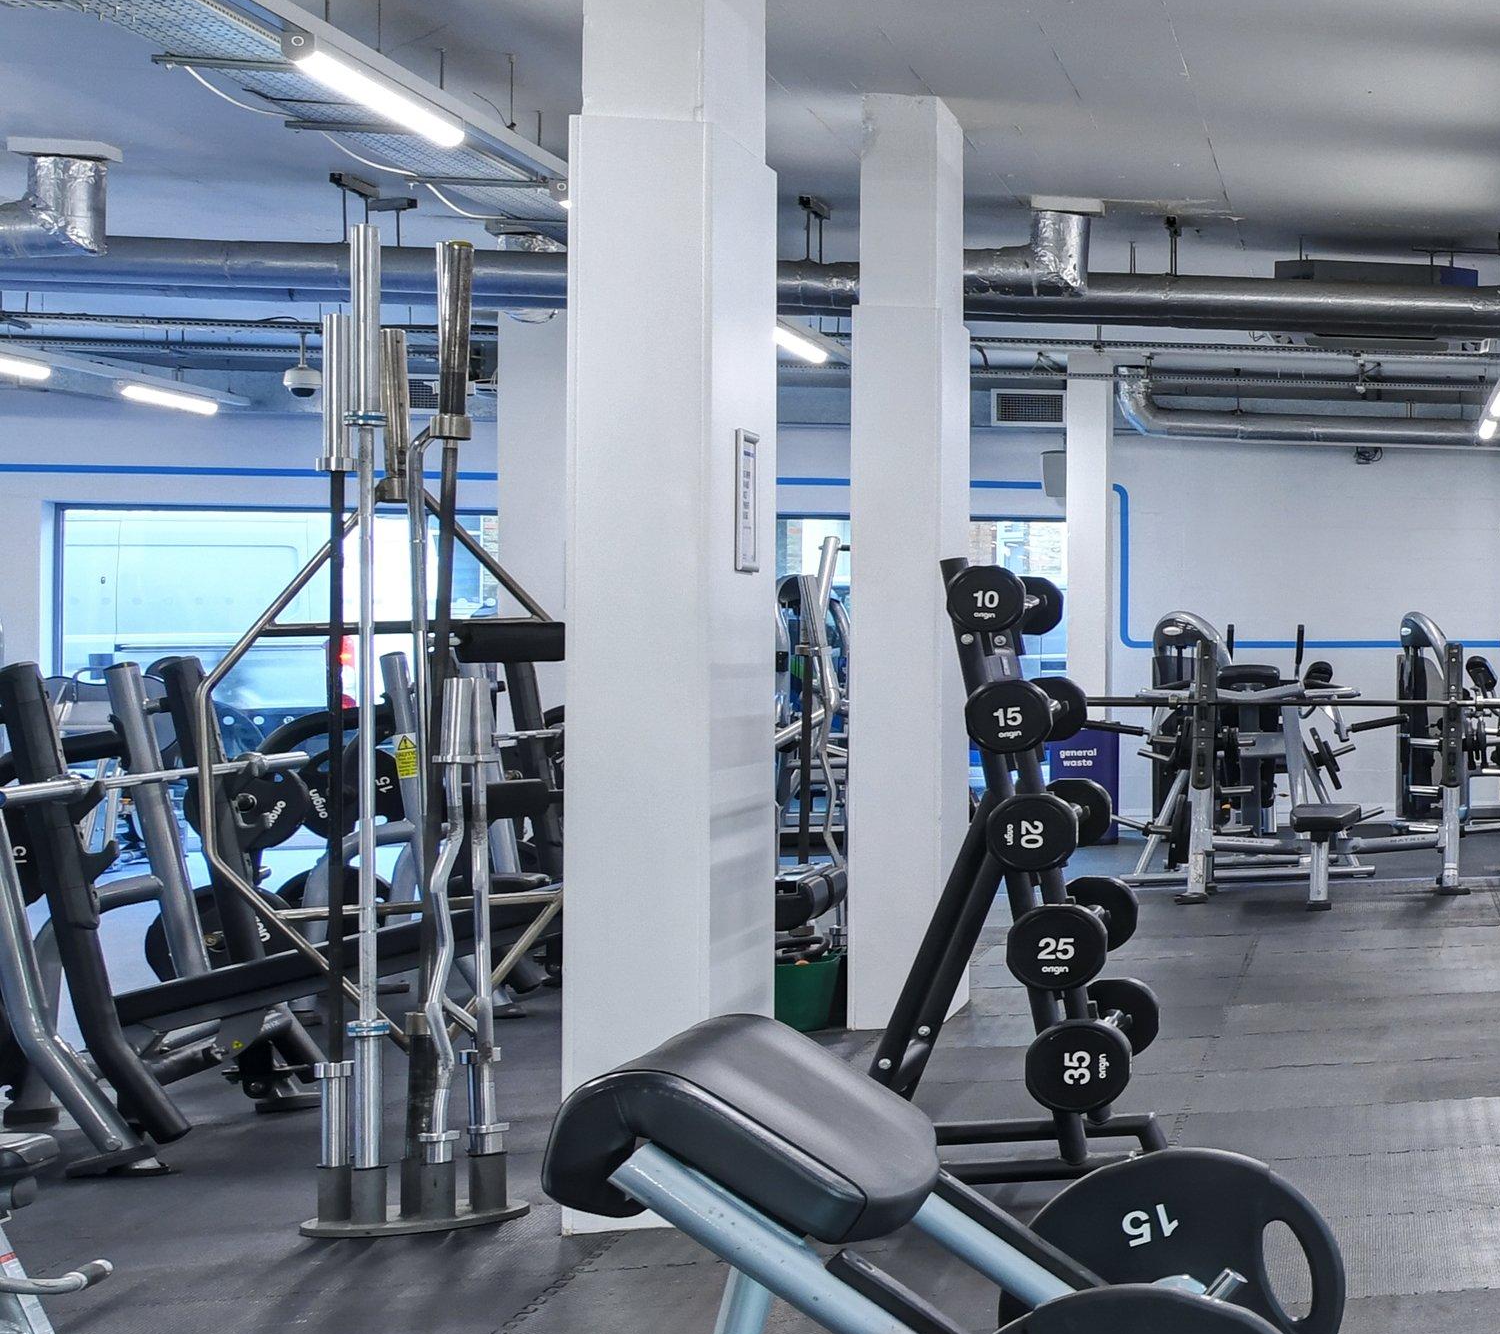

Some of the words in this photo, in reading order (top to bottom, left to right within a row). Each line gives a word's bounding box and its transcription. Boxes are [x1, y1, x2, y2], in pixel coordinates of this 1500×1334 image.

[973, 590, 999, 609] 10
[973, 611, 996, 621] origin
[993, 707, 1023, 727] 15
[998, 730, 1022, 739] origin
[1059, 748, 1097, 761] general
[1062, 758, 1093, 768] waste
[308, 788, 329, 819] origin
[1006, 823, 1014, 847] origin
[1020, 820, 1044, 850] 20
[1037, 937, 1075, 960] 25
[1041, 964, 1069, 975] origin
[1063, 1050, 1091, 1086] 35
[1097, 1053, 1108, 1080] origin
[1121, 1203, 1180, 1248] 15
